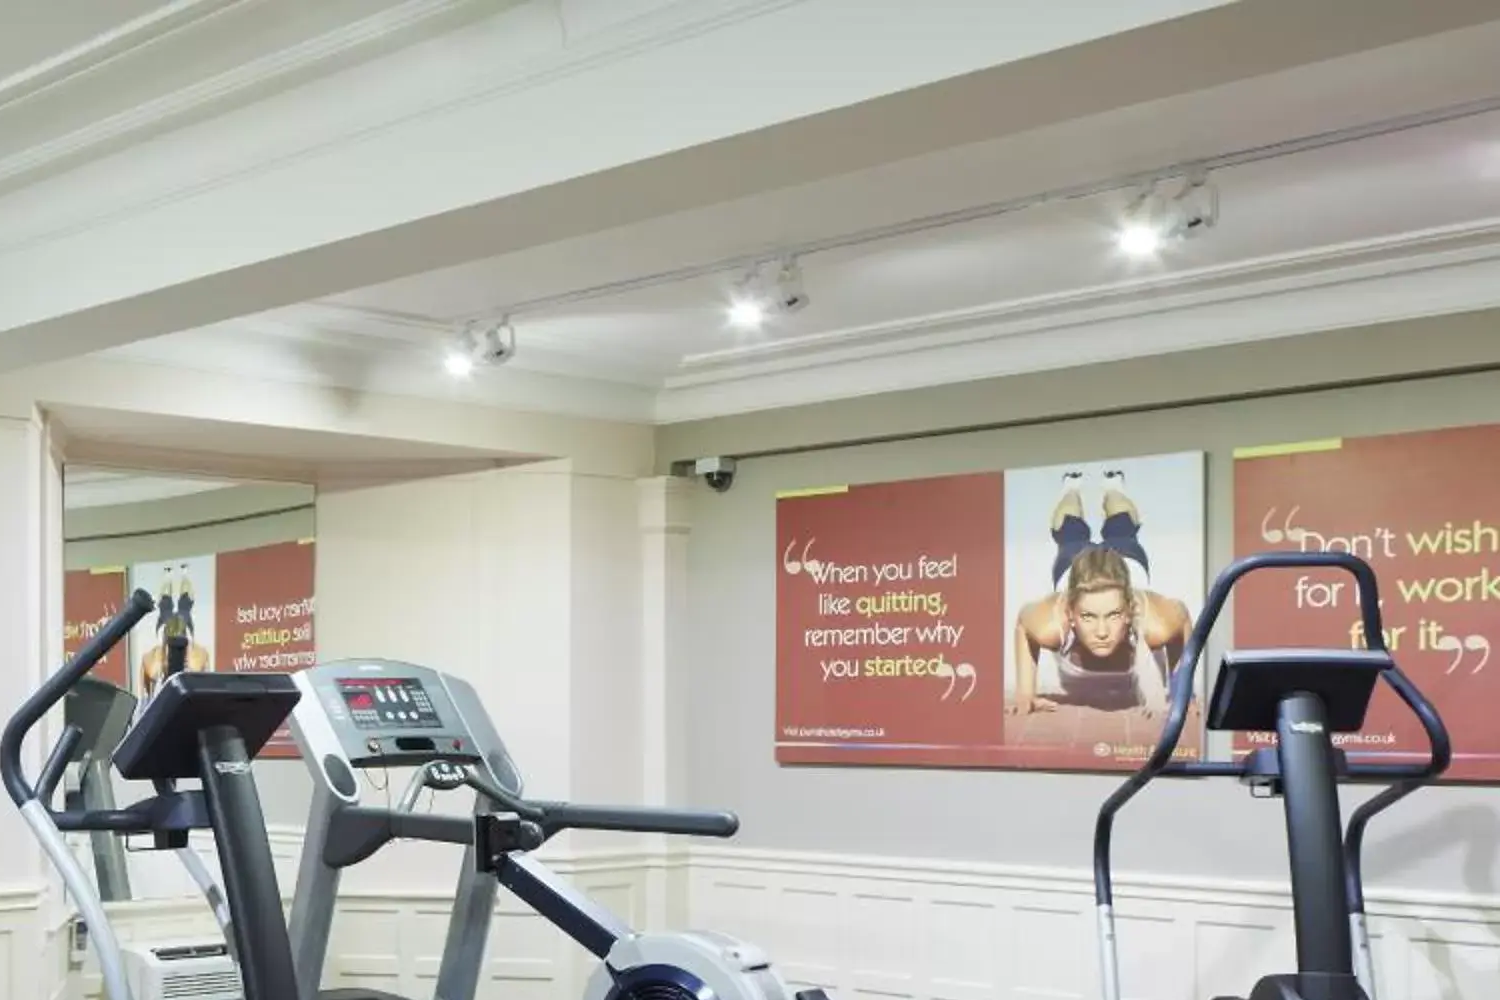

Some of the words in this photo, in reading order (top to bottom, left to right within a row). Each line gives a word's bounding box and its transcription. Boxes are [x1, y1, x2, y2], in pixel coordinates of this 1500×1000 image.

[1405, 519, 1498, 555] wish
[872, 562, 913, 587] you
[918, 552, 958, 580] feel
[819, 593, 851, 615] like
[855, 590, 948, 618] quitting,
[1295, 576, 1345, 609] for
[805, 622, 913, 647] remember
[915, 620, 965, 648] why
[820, 659, 860, 683] you
